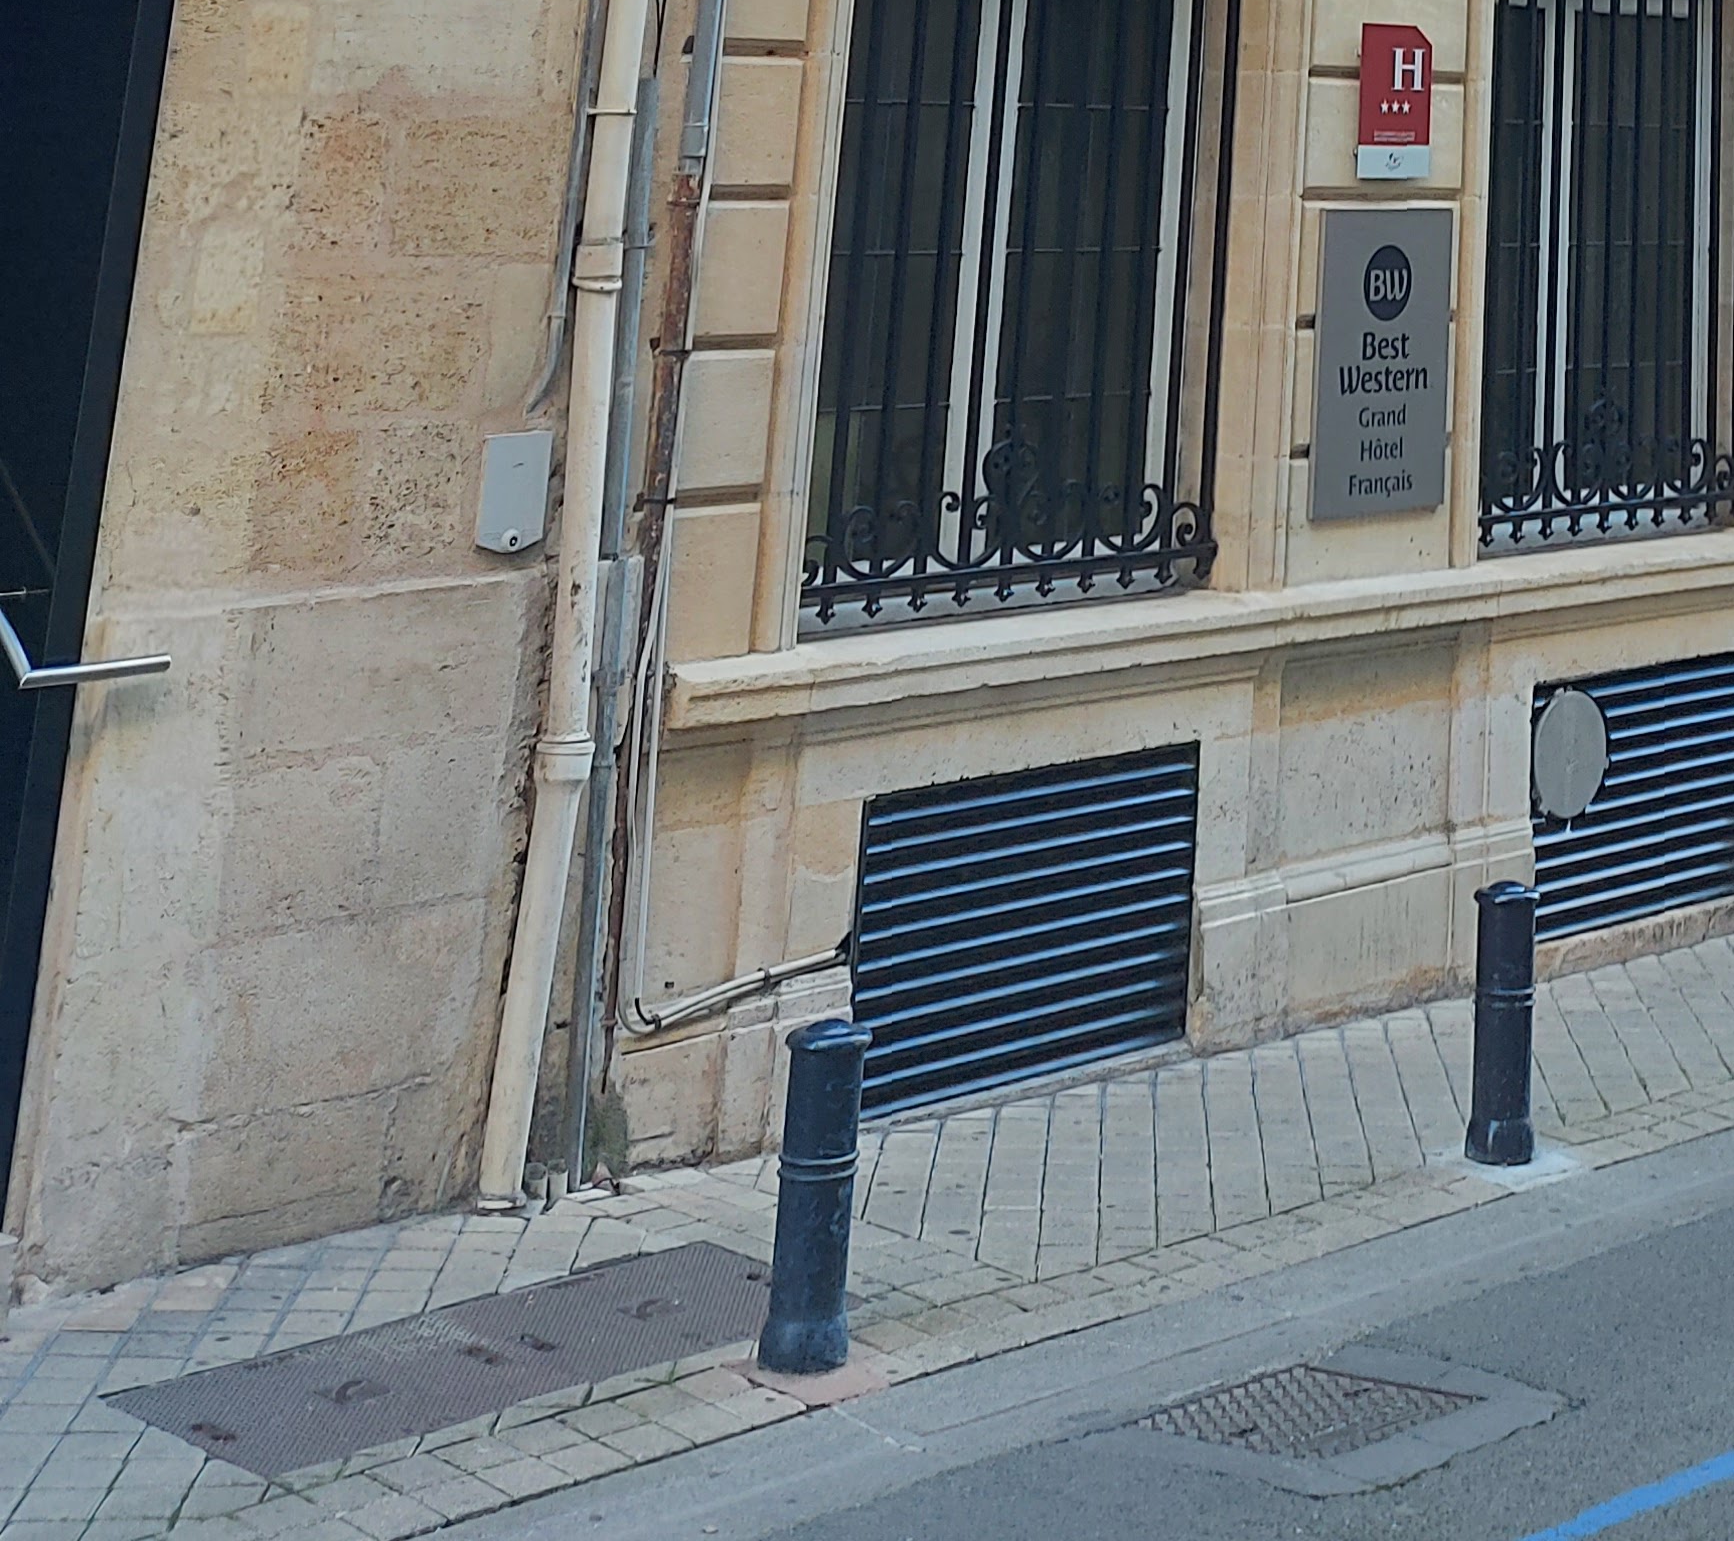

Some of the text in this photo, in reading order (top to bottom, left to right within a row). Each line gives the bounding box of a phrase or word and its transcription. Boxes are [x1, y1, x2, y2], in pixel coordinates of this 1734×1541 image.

[1391, 48, 1426, 91] H
[1369, 269, 1408, 302] BW
[1362, 331, 1409, 361] Best
[1339, 364, 1428, 396] Western
[1359, 406, 1406, 427] Grand
[1360, 438, 1404, 462] Hôtel
[1348, 471, 1412, 499] Français
